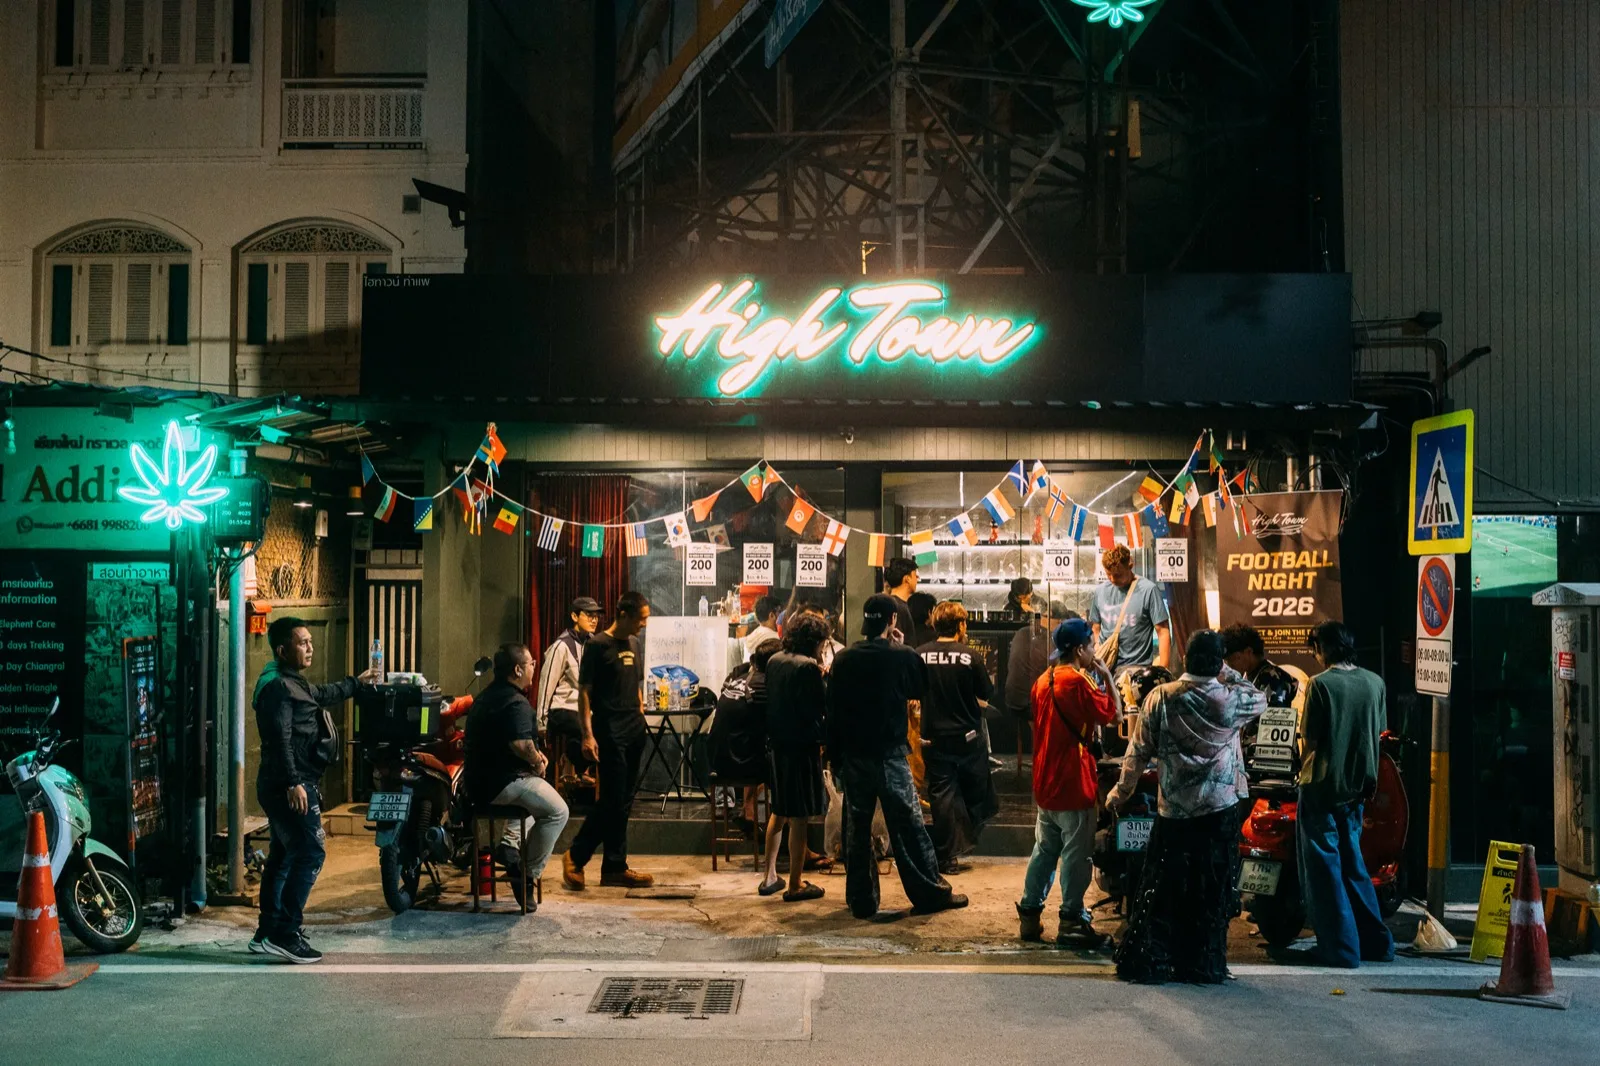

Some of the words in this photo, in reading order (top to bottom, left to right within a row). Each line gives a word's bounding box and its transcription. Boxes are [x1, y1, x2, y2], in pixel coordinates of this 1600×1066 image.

[655, 280, 847, 395] High
[848, 283, 1036, 364] Town
[1252, 513, 1280, 530] High
[1281, 512, 1308, 525] Town
[691, 559, 712, 570] 200
[748, 559, 769, 570] 200
[801, 560, 822, 571] 200
[1227, 550, 1333, 571] FOOTBALL
[99, 564, 169, 579] สอนทำอาหา
[1248, 572, 1317, 591] NIGHT
[0, 593, 57, 605] nformation
[1252, 597, 1314, 617] 2026
[36, 619, 56, 629] Care
[1274, 629, 1291, 637] JOIN
[7, 640, 27, 650] days
[29, 640, 64, 652] Trekking
[0, 683, 22, 692] olden
[25, 683, 58, 694] Triangle
[1124, 840, 1147, 850] 922
